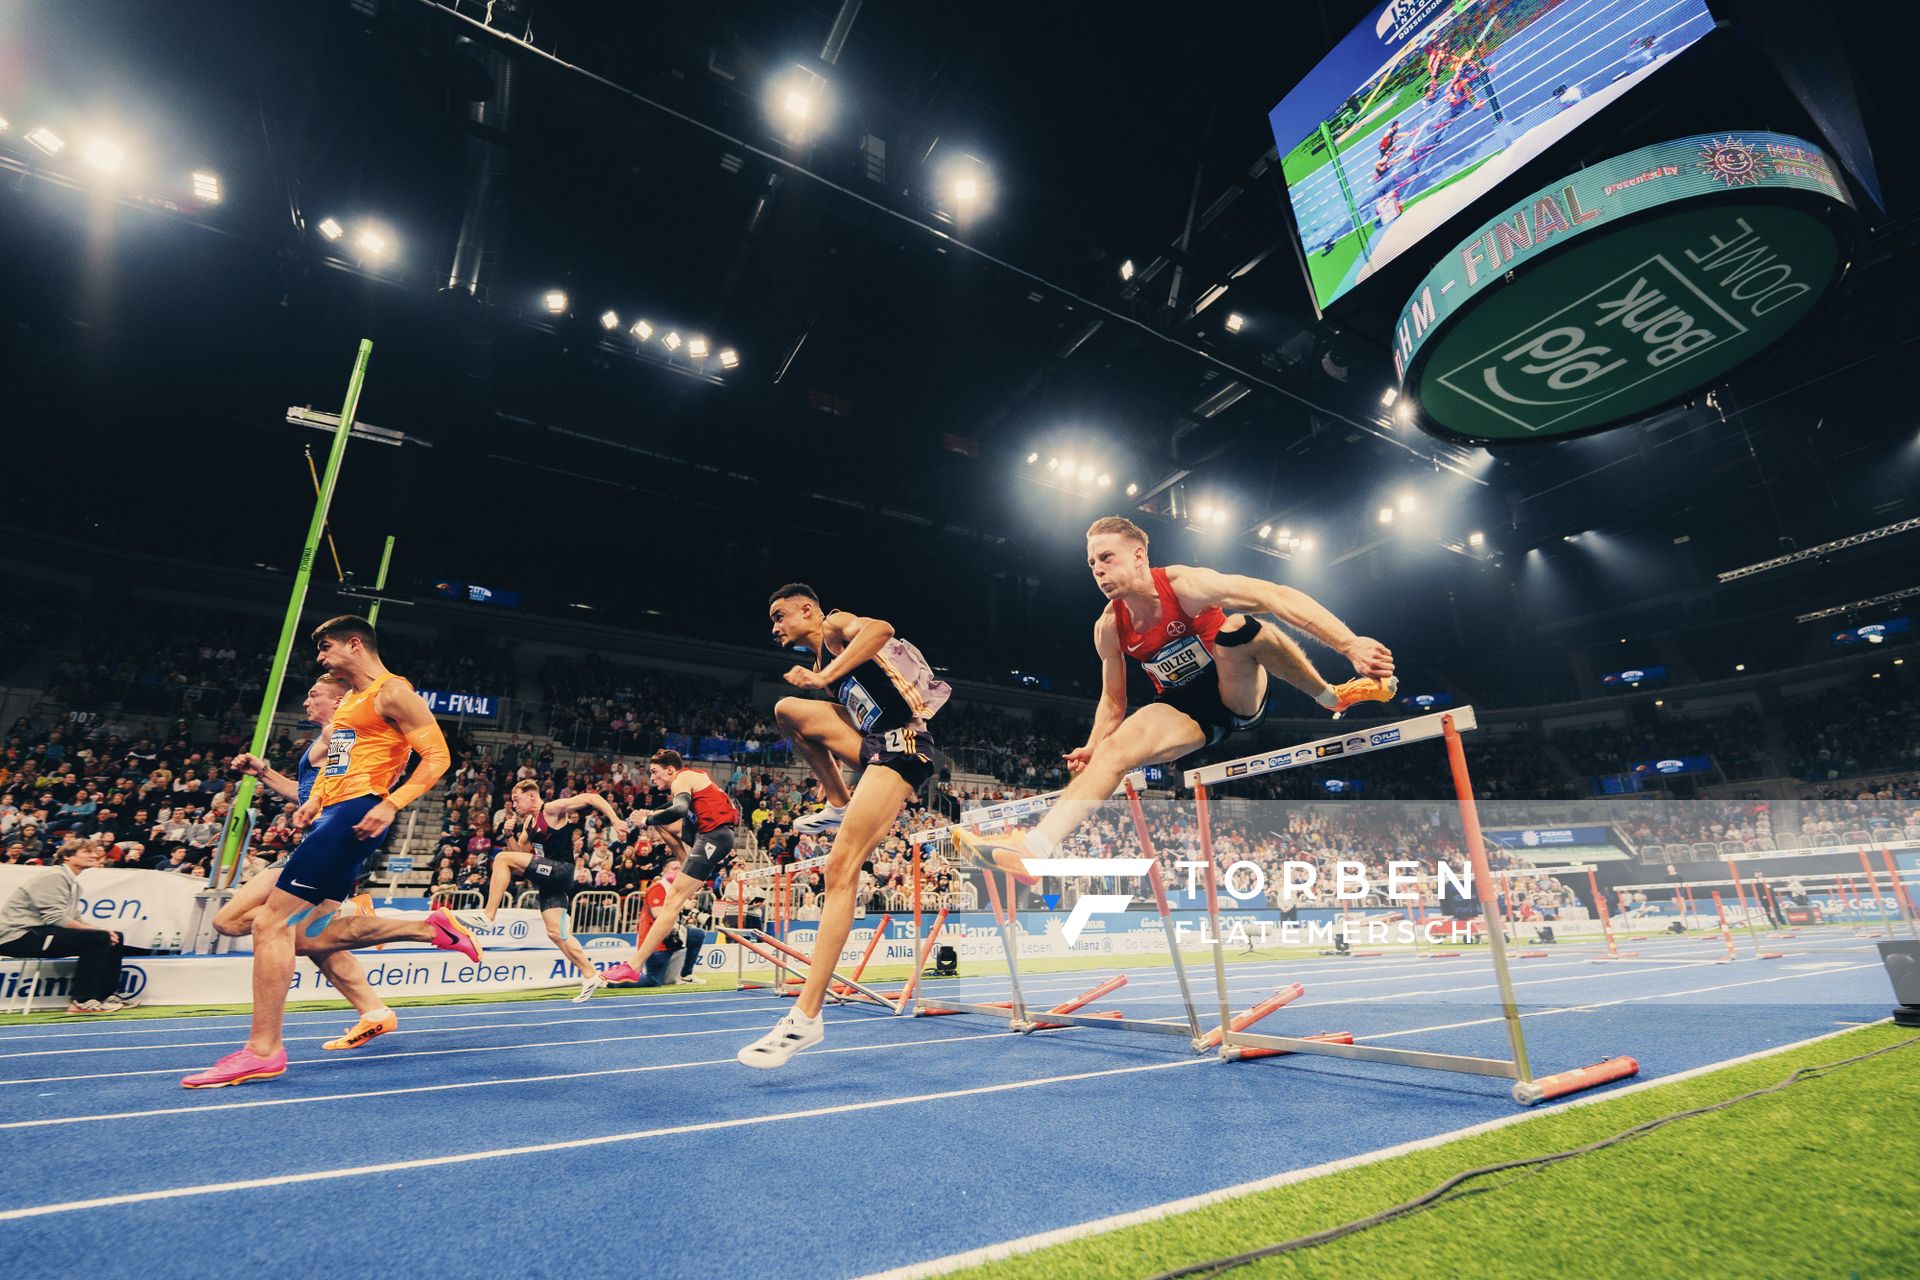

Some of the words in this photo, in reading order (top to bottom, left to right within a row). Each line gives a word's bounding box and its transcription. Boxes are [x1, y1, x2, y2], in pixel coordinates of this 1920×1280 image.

[1461, 185, 1600, 287] FINAL
[1603, 166, 1662, 196] presented
[1684, 217, 1811, 317] DOME
[1595, 276, 1716, 366] Bank
[448, 694, 489, 715] FINAL
[890, 731, 900, 748] 2
[367, 962, 430, 987] dein
[441, 960, 534, 984] Leben.
